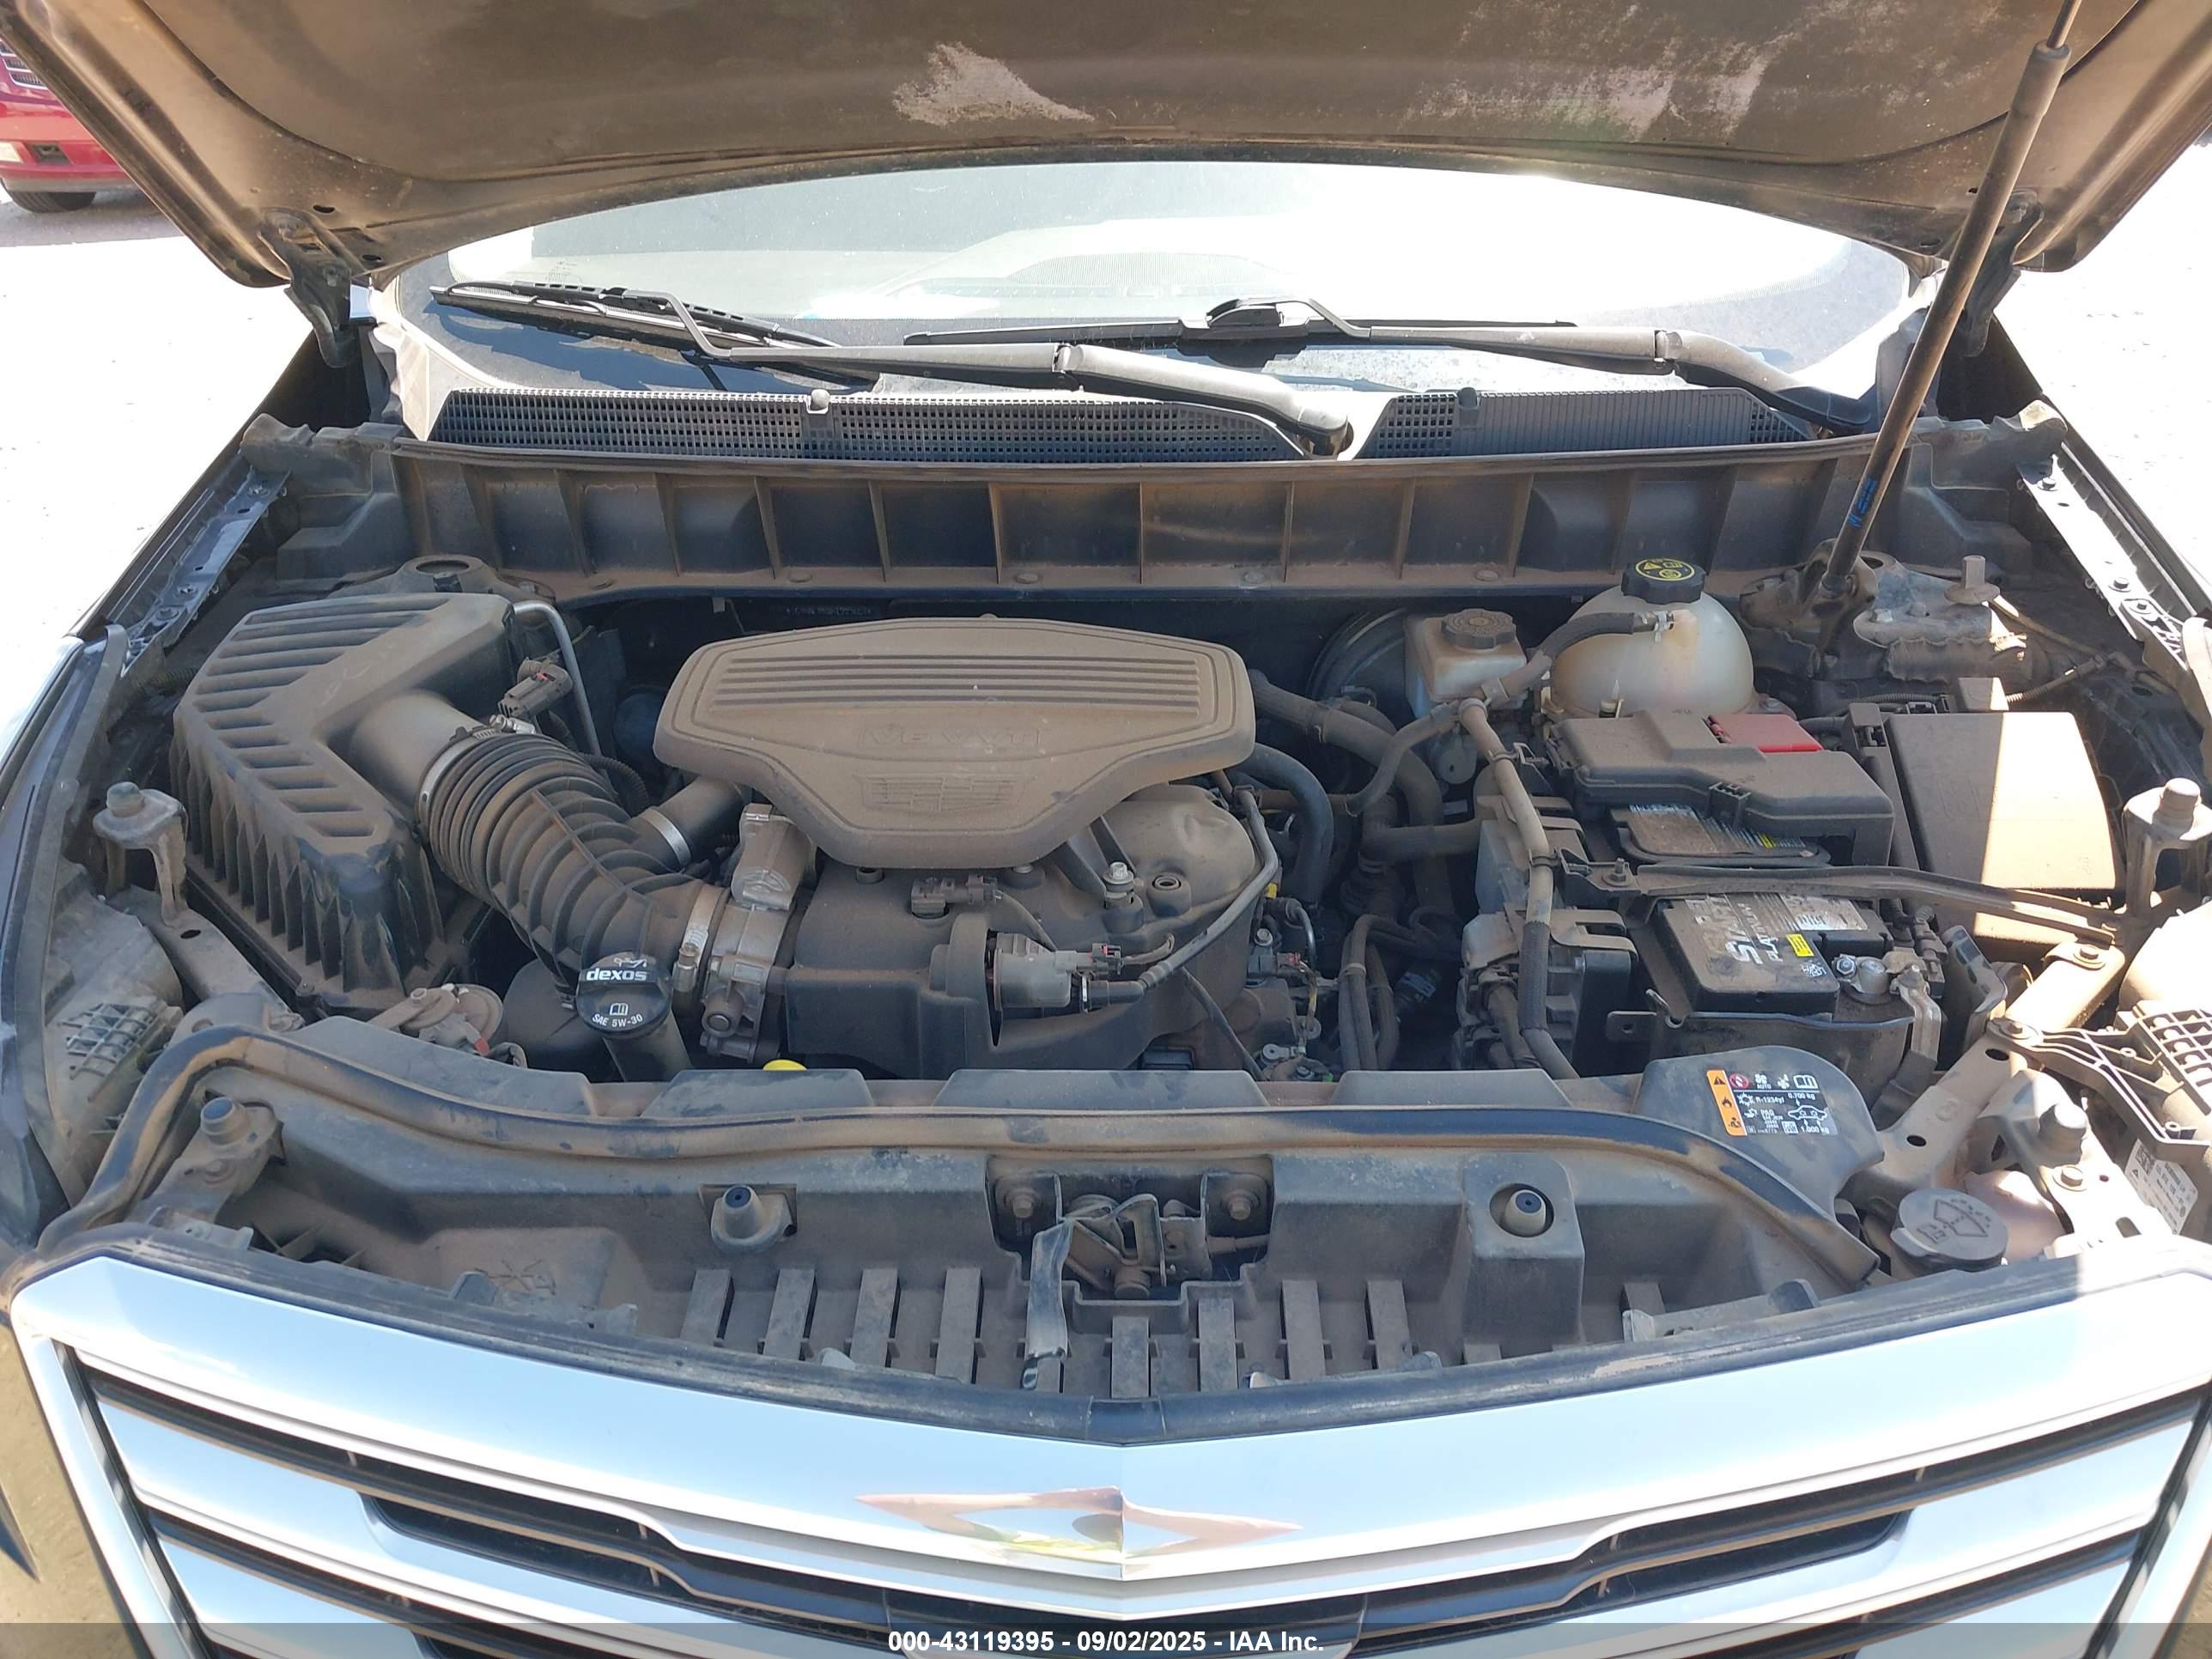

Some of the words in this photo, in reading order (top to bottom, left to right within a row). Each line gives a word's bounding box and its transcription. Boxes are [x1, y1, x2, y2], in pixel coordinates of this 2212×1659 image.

[586, 968, 647, 981] dexos
[592, 1013, 609, 1026] SAE
[611, 1013, 643, 1028] 5W-30
